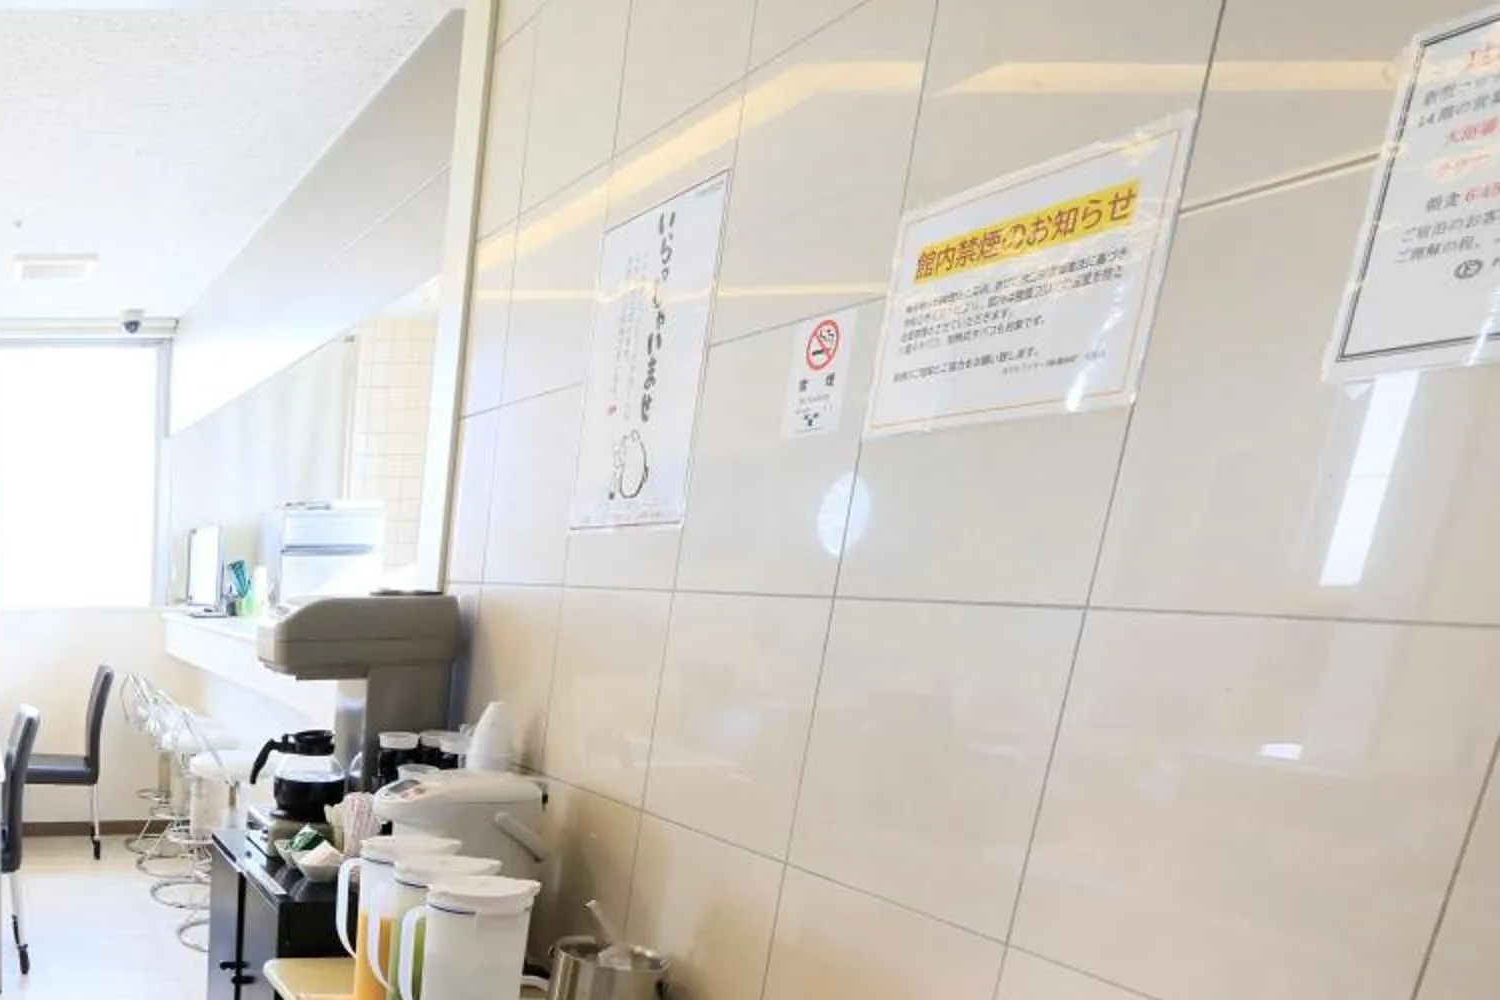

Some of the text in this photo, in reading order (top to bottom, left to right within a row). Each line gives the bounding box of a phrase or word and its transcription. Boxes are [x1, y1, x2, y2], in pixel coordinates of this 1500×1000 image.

[915, 187, 1137, 281] 館内禁煙のお知らせ
